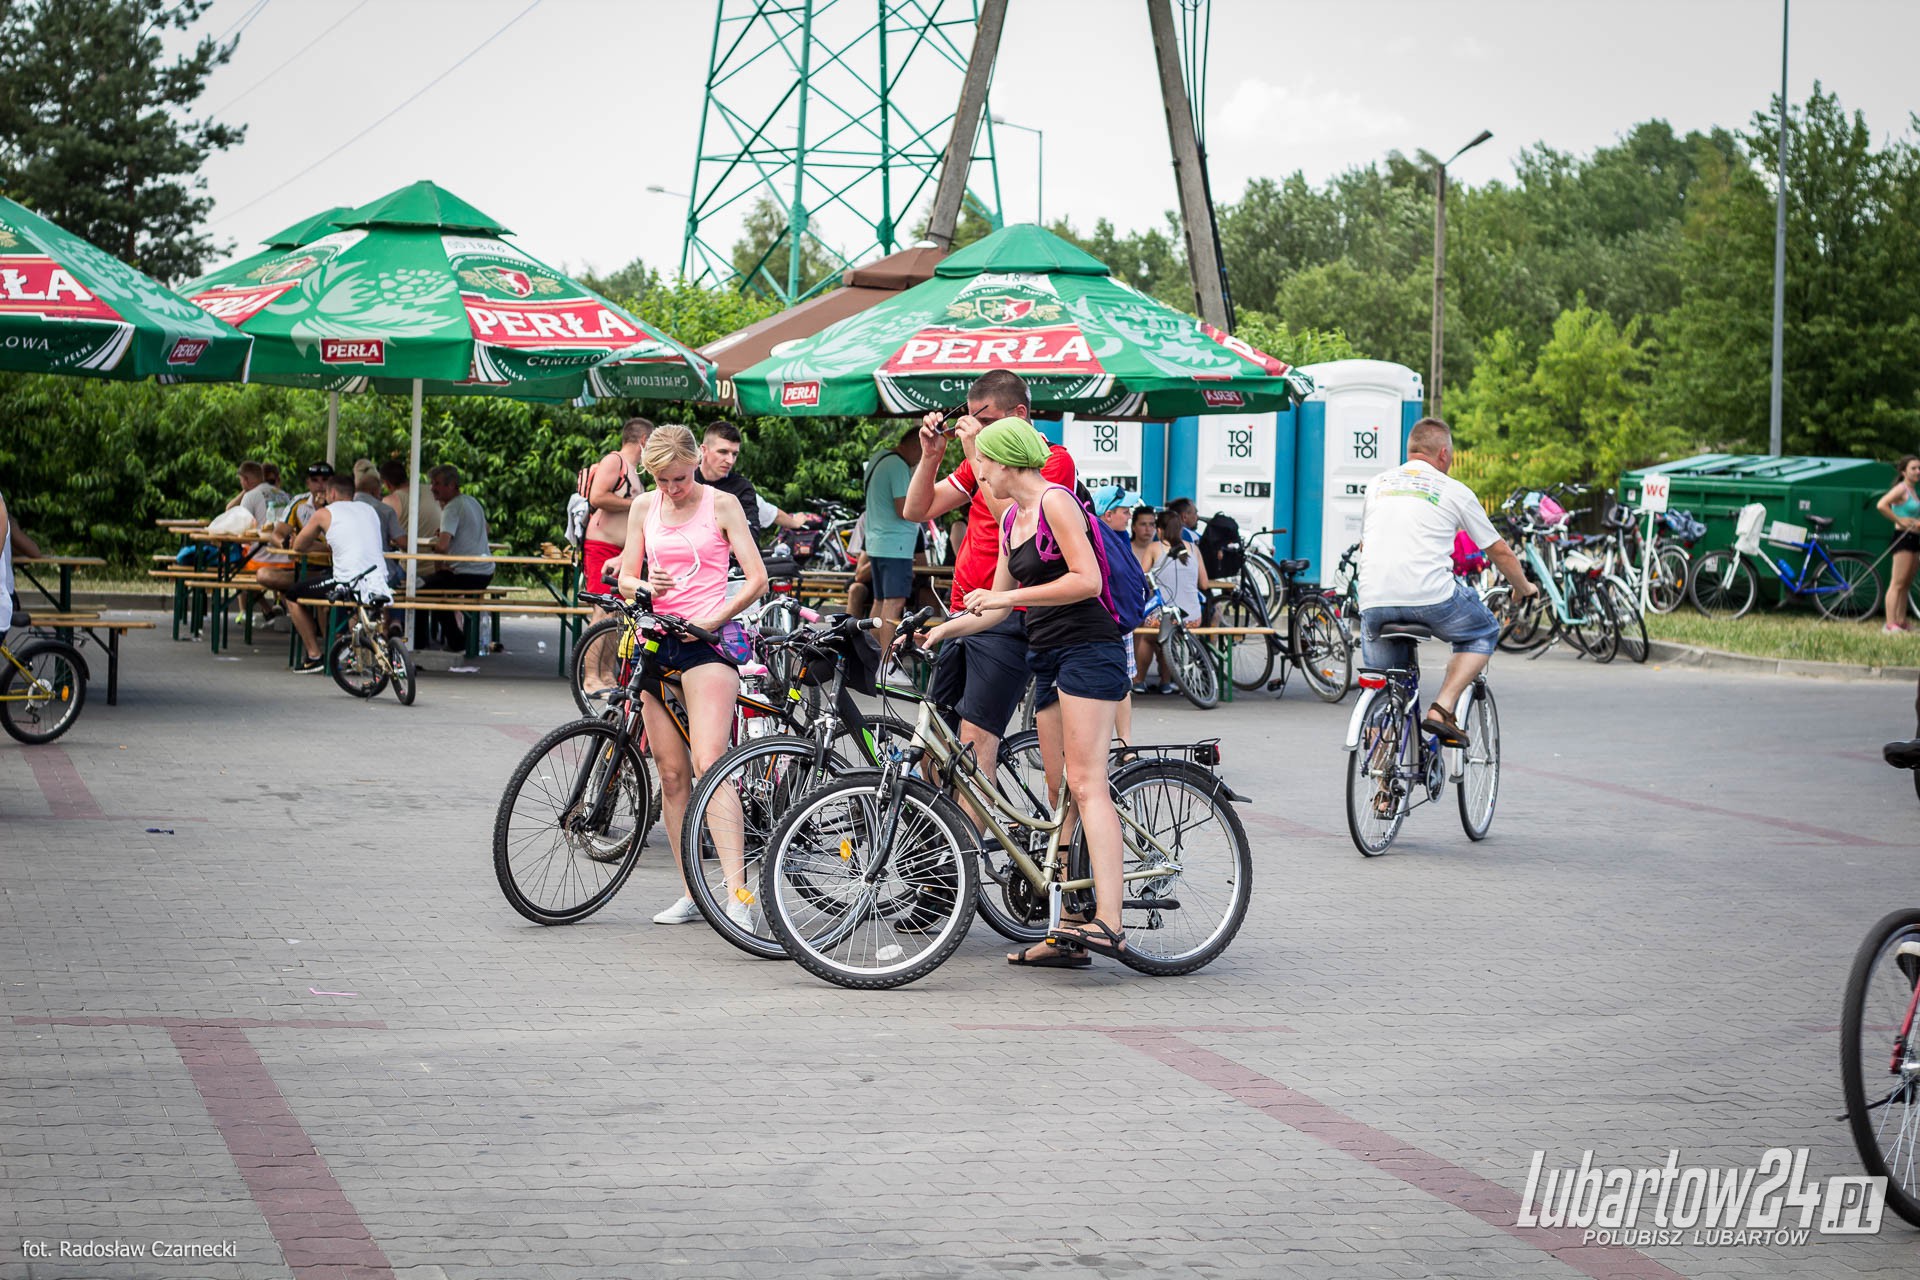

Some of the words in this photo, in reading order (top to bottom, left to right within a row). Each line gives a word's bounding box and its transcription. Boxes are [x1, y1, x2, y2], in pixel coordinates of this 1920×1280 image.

[0, 268, 94, 301] ŁA
[465, 306, 637, 338] PERŁA
[0, 335, 50, 351] OWA
[896, 335, 1094, 365] PERŁA
[326, 343, 380, 359] PERŁA
[784, 385, 818, 401] PERŁA
[1093, 425, 1118, 438] TOI
[1228, 430, 1252, 443] TOI
[1353, 431, 1378, 445] TOI
[1093, 439, 1118, 452] TOI
[1227, 444, 1252, 458] TOI
[1353, 445, 1377, 459] TOI
[1646, 483, 1666, 497] WC
